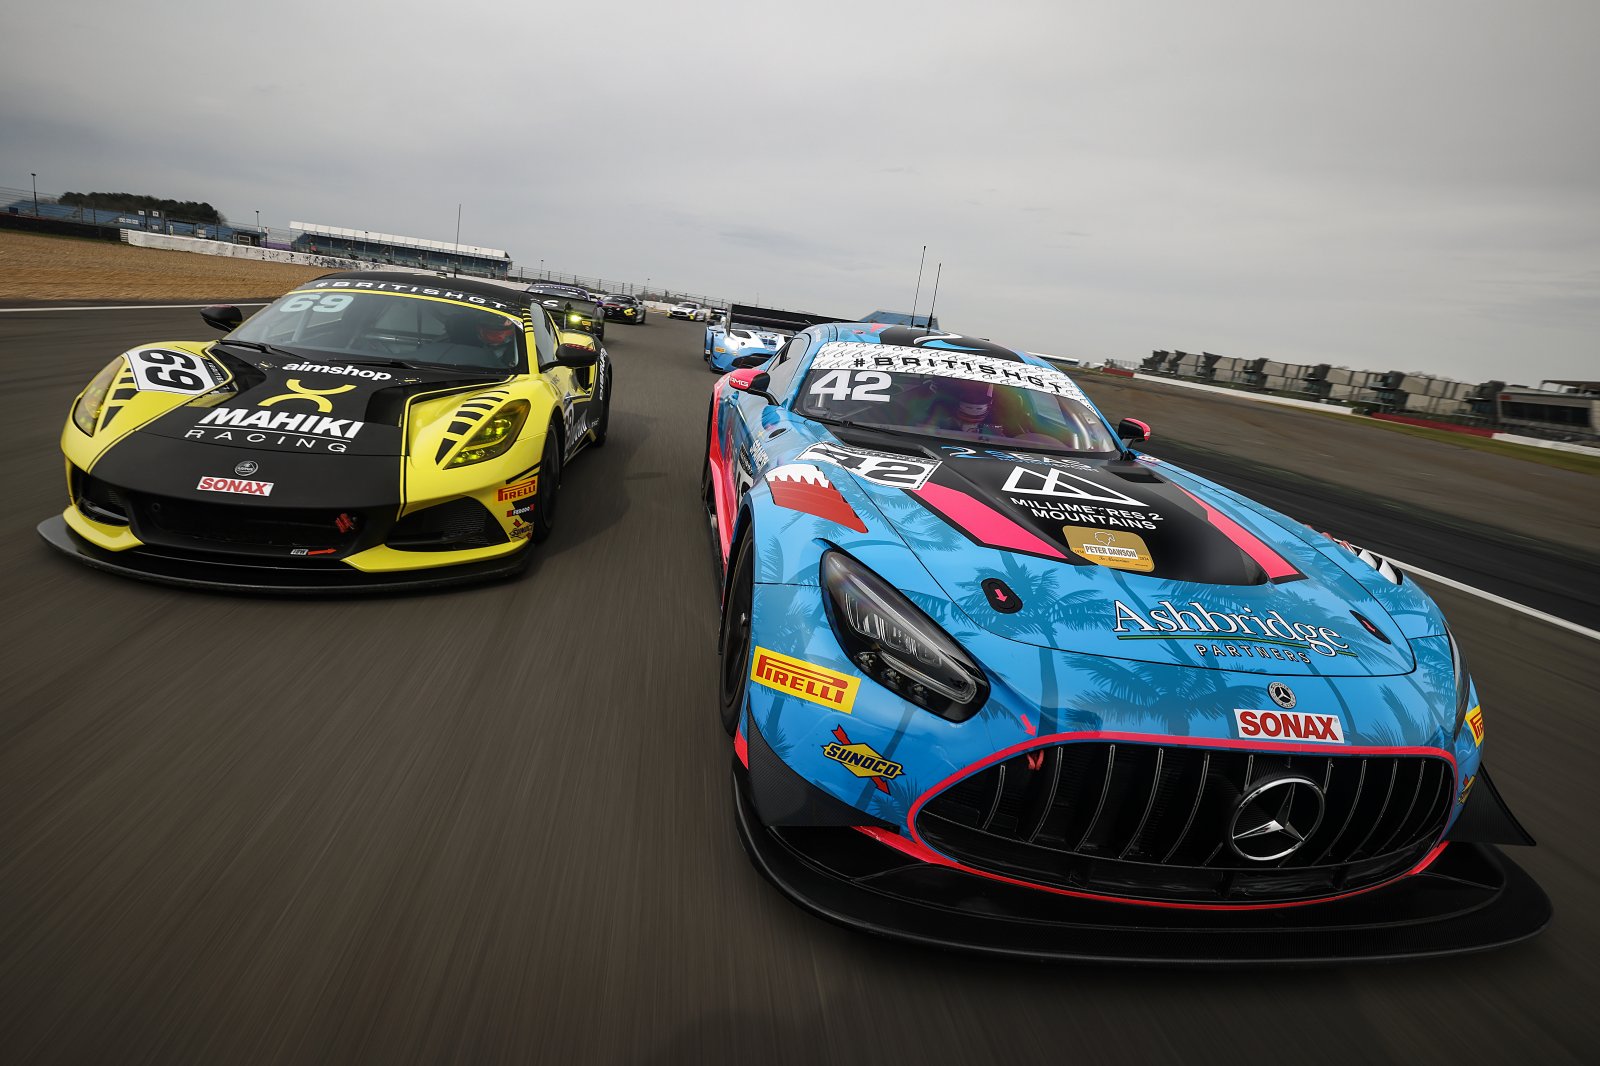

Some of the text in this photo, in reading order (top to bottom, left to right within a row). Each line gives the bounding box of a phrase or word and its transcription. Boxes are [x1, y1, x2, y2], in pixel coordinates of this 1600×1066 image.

[279, 292, 354, 313] 69
[315, 281, 508, 309] #BRITISHGT
[139, 349, 204, 391] 69
[282, 362, 392, 381] aimshop
[730, 377, 749, 387] AMG
[853, 357, 1064, 393] #BRITISHGT
[809, 369, 892, 402] 42
[198, 408, 364, 439] MAHIKI
[184, 429, 347, 453] RACING
[809, 448, 925, 484] 42
[199, 478, 268, 495] SONAX
[497, 479, 536, 502] PIRELLI
[1032, 508, 1157, 529] MOUNTAINS
[1148, 512, 1164, 521] 2
[1085, 545, 1138, 558] PETER DAWSON
[1113, 600, 1349, 657] Ashbridge
[1194, 644, 1312, 664] PARTNERS
[755, 654, 848, 704] PIRELLI
[1239, 711, 1339, 740] SONAX
[826, 744, 899, 777] SUNOCO
